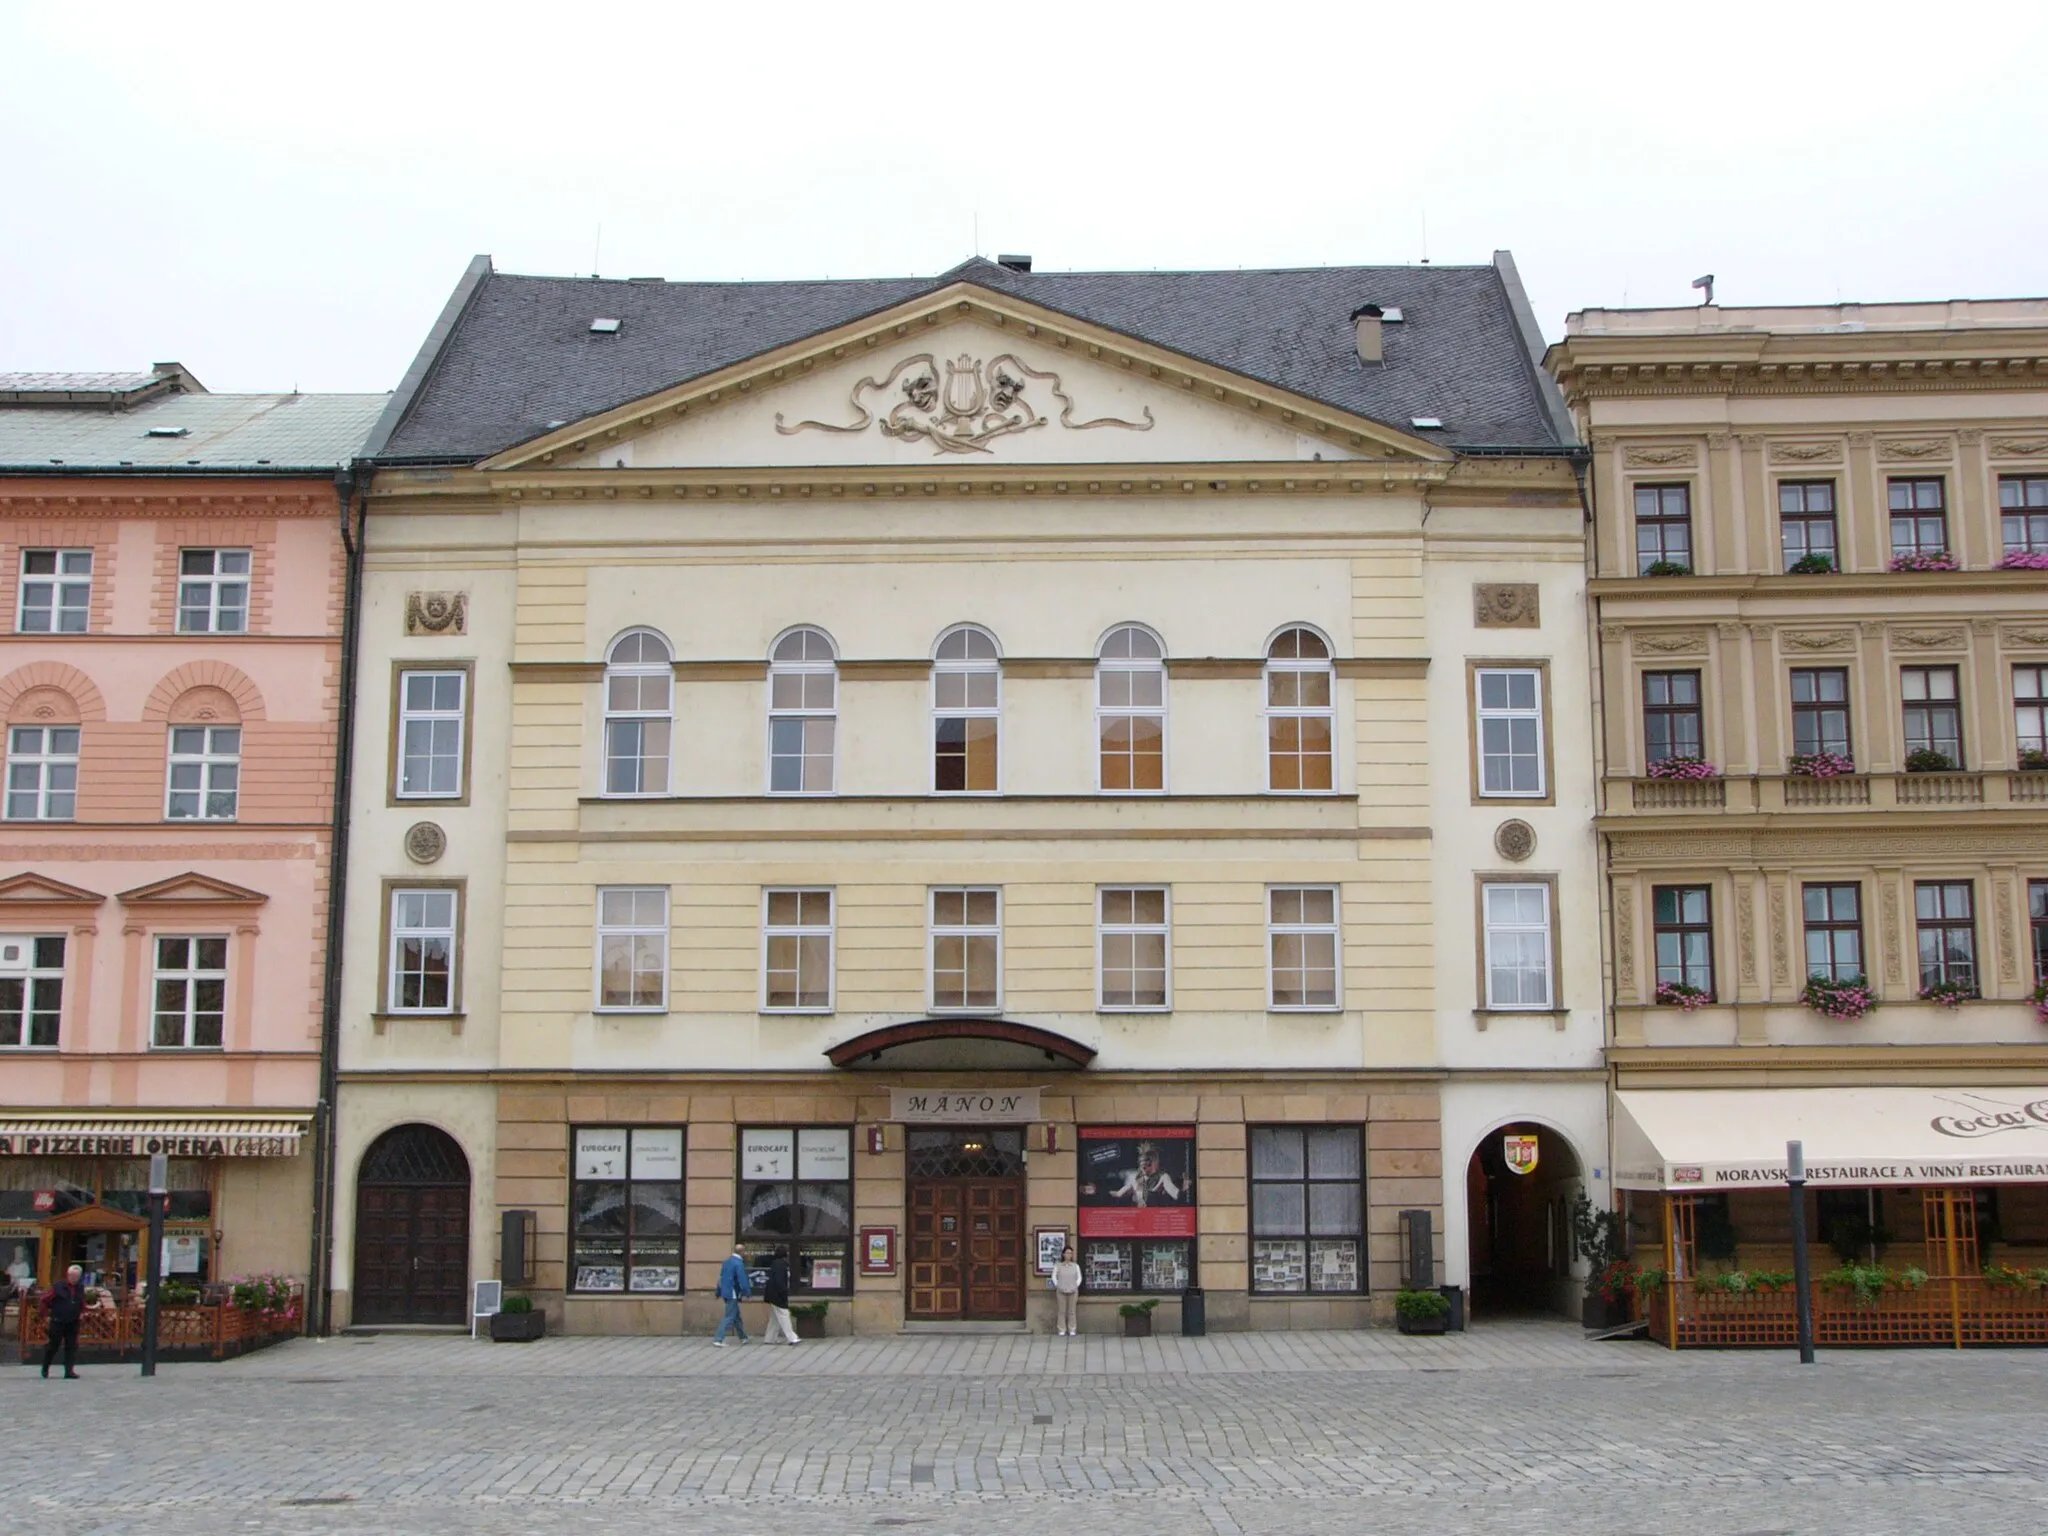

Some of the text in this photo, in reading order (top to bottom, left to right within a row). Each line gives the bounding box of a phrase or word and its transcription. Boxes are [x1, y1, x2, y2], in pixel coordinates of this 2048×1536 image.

[907, 1095, 1021, 1113] MANON
[1930, 1099, 2048, 1138] Coca-C
[26, 1138, 133, 1153] PIZZERIE
[147, 1139, 225, 1154] OPERA
[1715, 1162, 2048, 1182] MORAVSK RESTAURACE A VINNÝ RESTAURA
